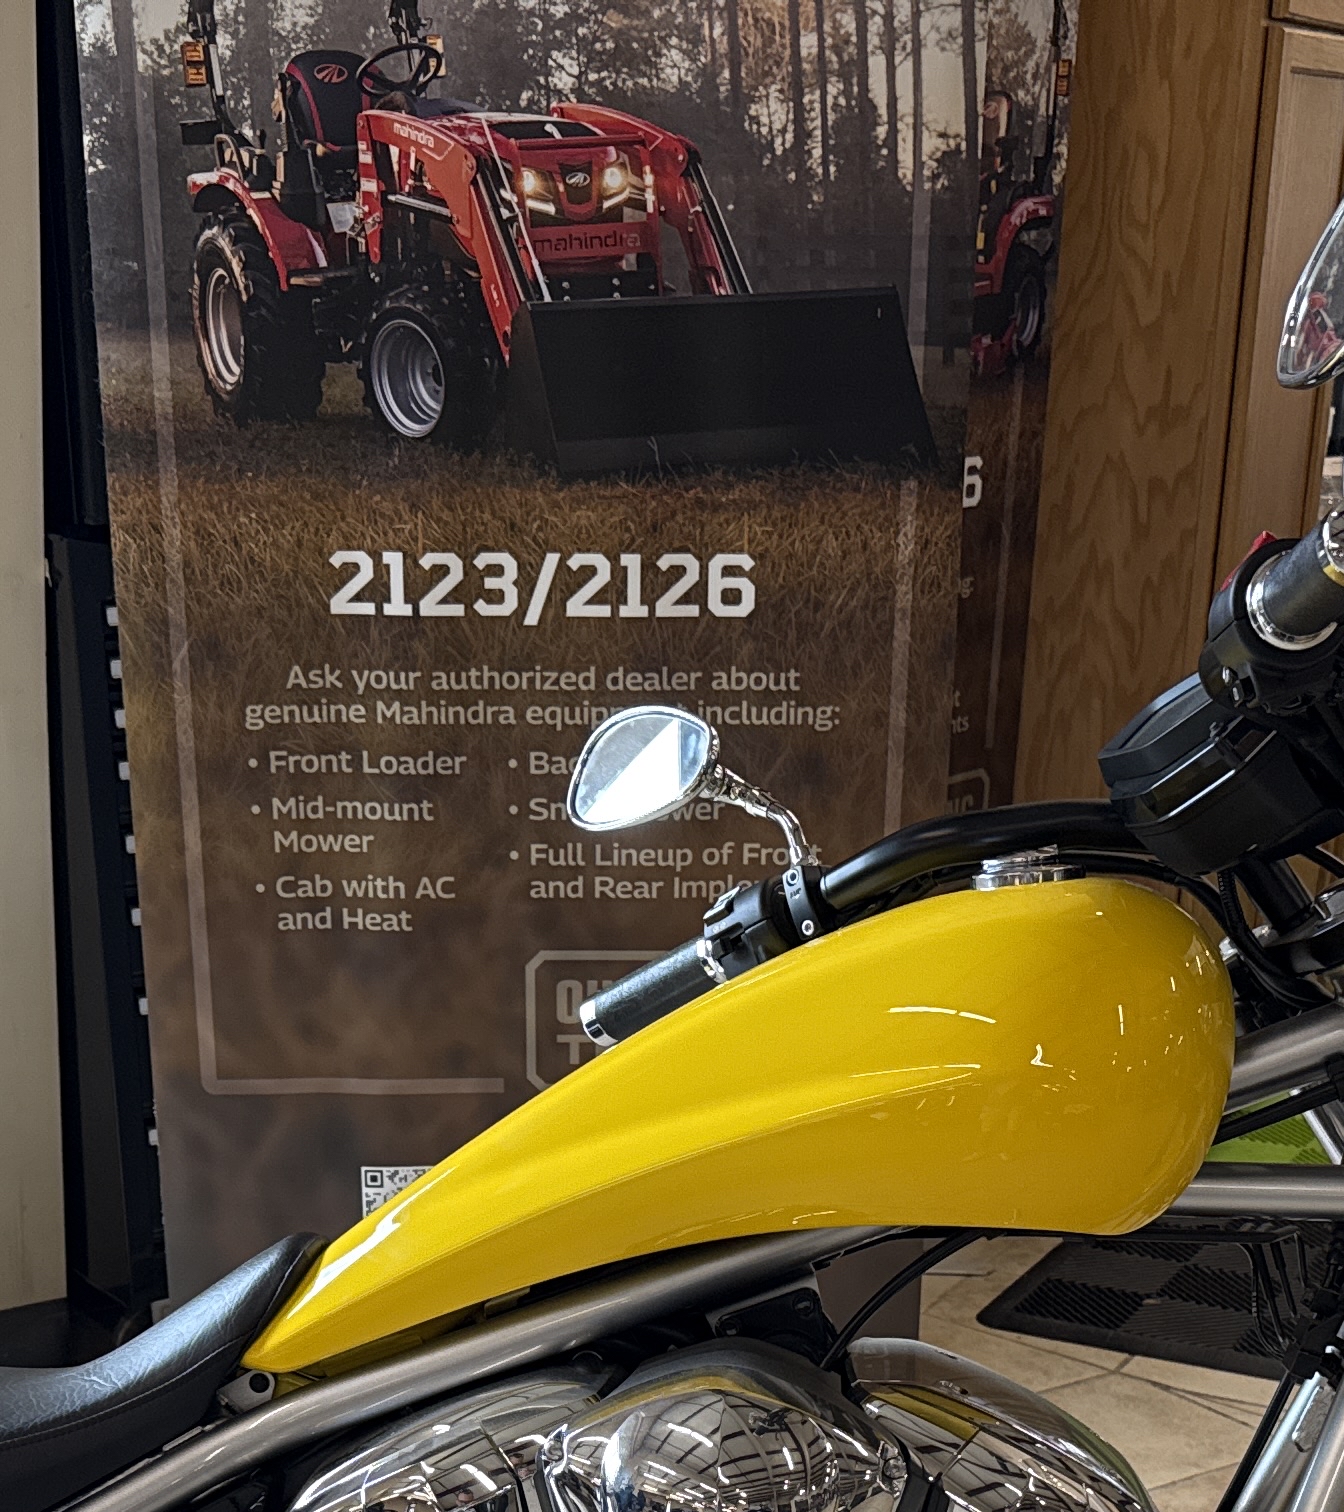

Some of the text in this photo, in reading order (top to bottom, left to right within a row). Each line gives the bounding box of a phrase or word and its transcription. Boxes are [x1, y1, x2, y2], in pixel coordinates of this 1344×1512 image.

[392, 121, 435, 149] mahindra
[532, 231, 641, 254] mahindra
[328, 550, 756, 626] 2123/2126
[286, 663, 801, 695] Ask your authorized dealer about
[244, 698, 367, 731] genuine
[376, 700, 517, 726] Mahindra
[697, 699, 841, 732] including:
[268, 750, 467, 775] Front Loader
[271, 795, 434, 821] Mid-mount
[273, 830, 374, 853] Mower
[529, 841, 823, 872] Full Lineup of Frot
[275, 873, 456, 900] Cab with AC
[529, 876, 584, 900] and
[594, 876, 664, 899] Rear
[277, 906, 413, 932] and Heat
